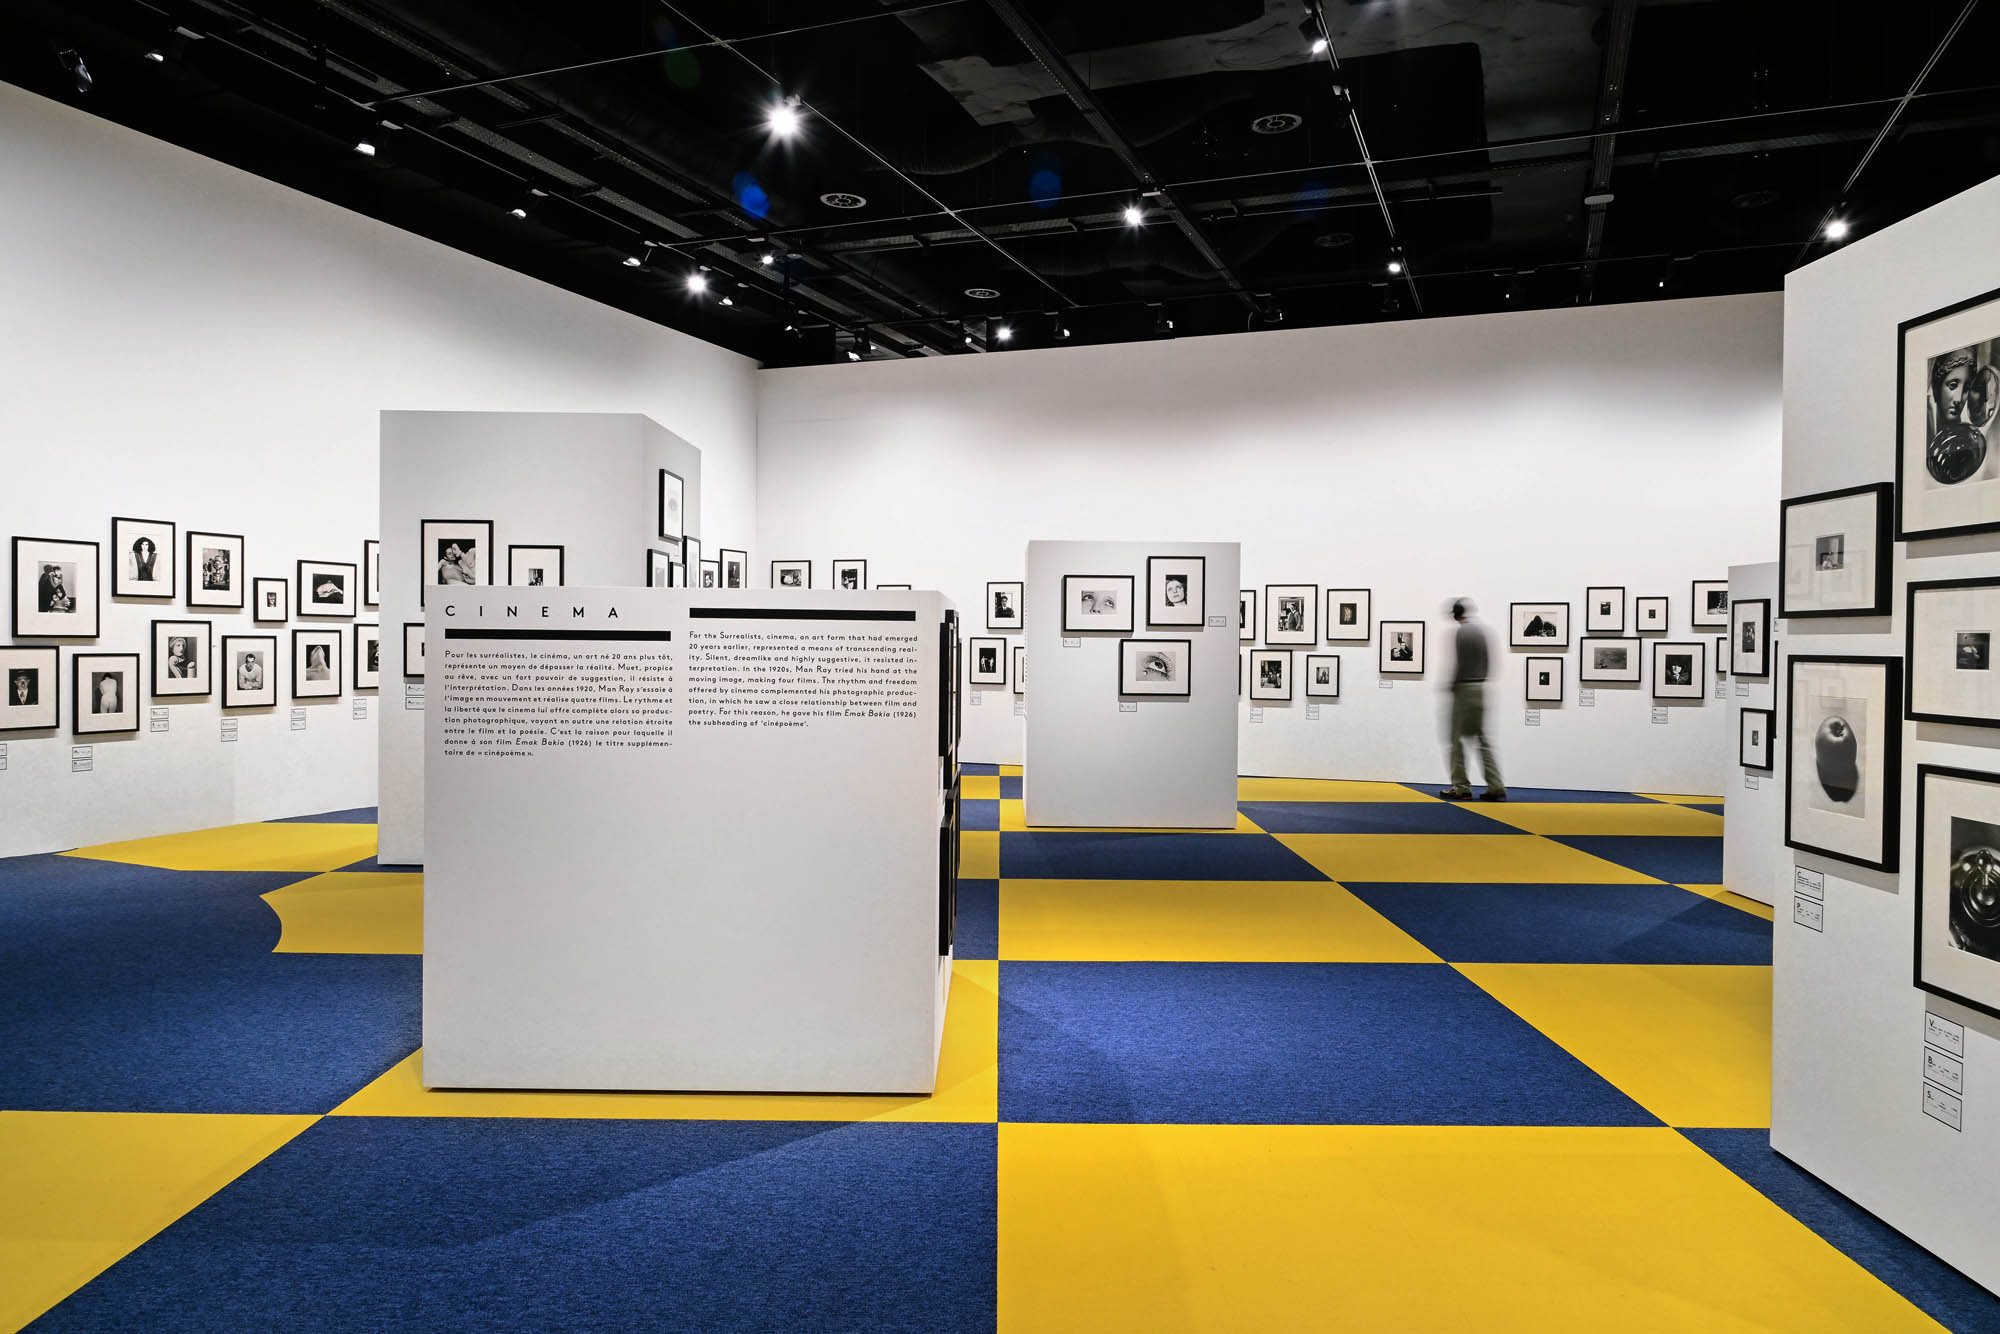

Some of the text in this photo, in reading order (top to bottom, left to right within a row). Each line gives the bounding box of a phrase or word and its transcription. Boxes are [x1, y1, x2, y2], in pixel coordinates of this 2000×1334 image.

[445, 605, 618, 618] CINEMA
[706, 653, 731, 661] Silent,
[816, 665, 832, 674] Ray
[619, 685, 634, 694] Ray
